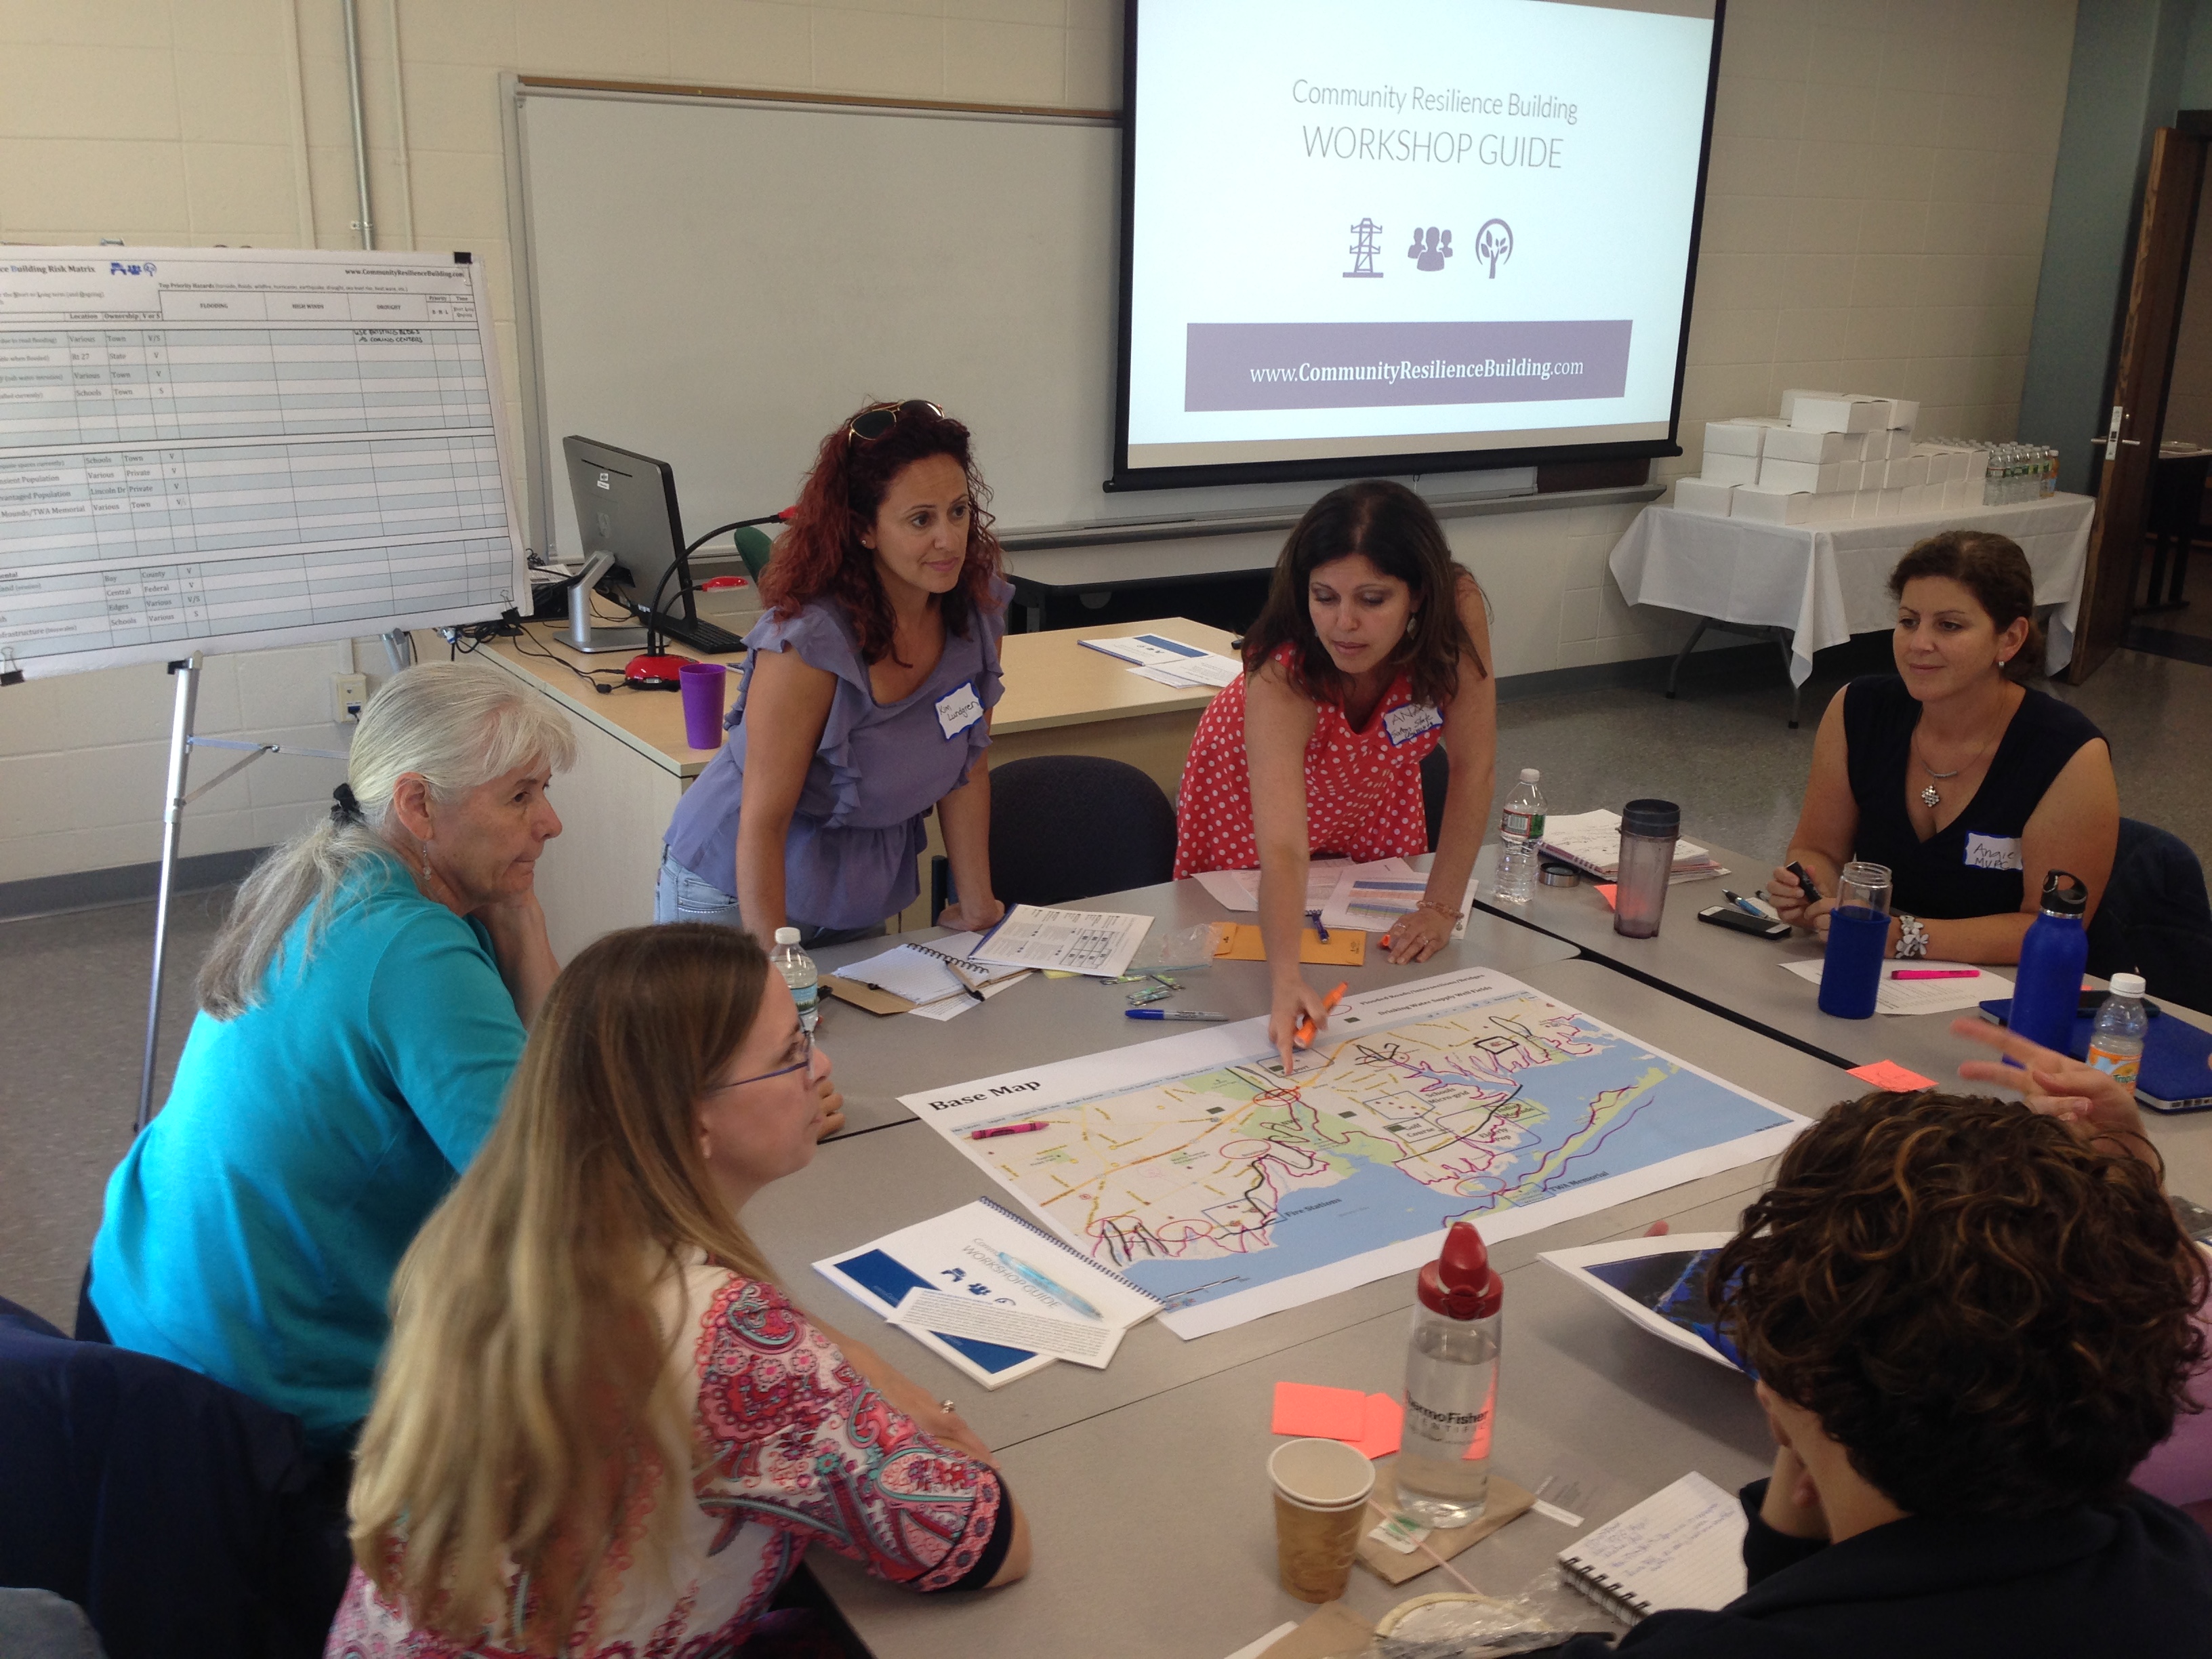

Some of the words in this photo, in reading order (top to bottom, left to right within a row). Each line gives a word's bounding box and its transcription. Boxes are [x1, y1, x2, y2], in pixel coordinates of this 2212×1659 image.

[1292, 79, 1407, 115] Community
[1412, 86, 1503, 115] Resilience
[1508, 92, 1578, 125] Building
[1303, 125, 1473, 164] WORKSHOP
[1479, 134, 1564, 169] GUIDE
[10, 265, 47, 274] Building
[345, 269, 465, 279] www.CommunityResilienceBuilding.com
[1250, 358, 1584, 384] www.CommunityResilienceBuilding.com
[85, 456, 112, 464] Schools
[22, 475, 60, 484] Population
[33, 491, 71, 499] Population
[91, 487, 116, 495] Lincoln
[52, 505, 85, 514] Memorial
[106, 588, 131, 596] Central
[144, 584, 169, 593] Federal
[146, 598, 172, 607] Various
[187, 595, 201, 603] V/S
[108, 604, 129, 612] Edges
[148, 613, 175, 621] Various
[110, 618, 137, 626] Schools
[938, 704, 953, 716] Kim
[947, 701, 979, 721] Lundgren
[1973, 843, 2015, 859] Angie
[1360, 996, 1389, 1005] Flooded
[1378, 1004, 1410, 1015] Drinking
[1410, 999, 1432, 1008] Water
[1431, 994, 1456, 1003] Supply
[1469, 985, 1493, 994] Fields
[928, 1093, 988, 1111] Base
[987, 1081, 1042, 1097] Map
[1425, 1087, 1456, 1098] Schools
[1428, 1090, 1471, 1104] Micro-grid
[1404, 1122, 1422, 1131] Golf
[1407, 1128, 1435, 1139] Course
[1548, 1183, 1570, 1192] TWA
[1568, 1171, 1610, 1187] Memorial
[1284, 1209, 1304, 1218] Fire
[1303, 1197, 1343, 1212] Stations
[962, 1245, 1025, 1286] WORKSHOP
[1024, 1285, 1063, 1309] GUIDE
